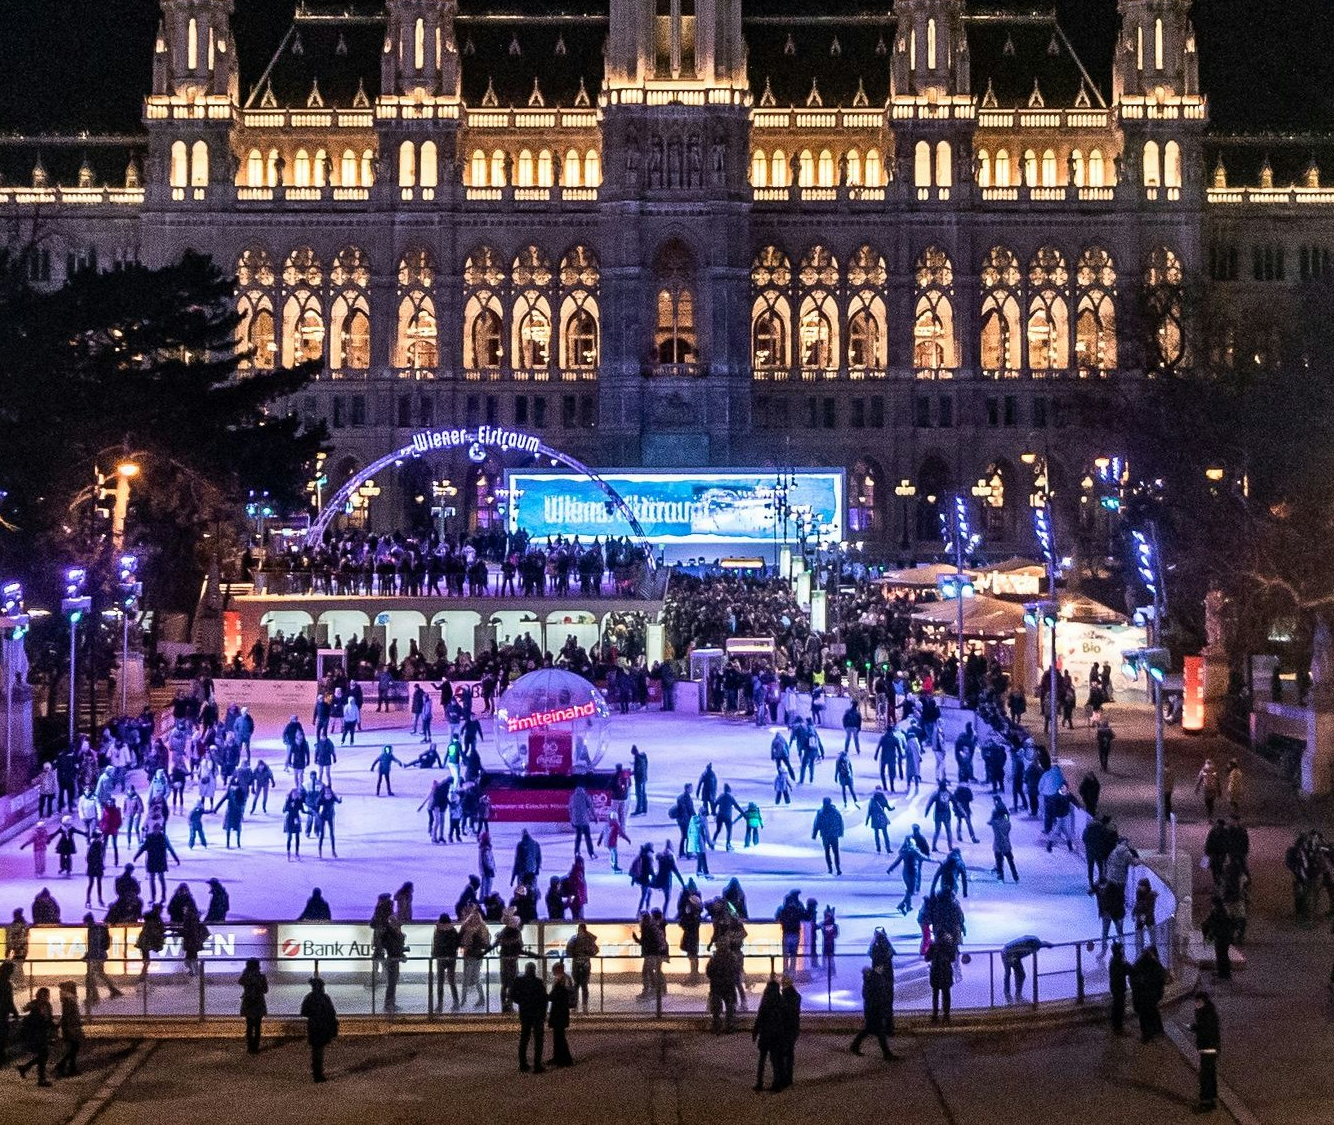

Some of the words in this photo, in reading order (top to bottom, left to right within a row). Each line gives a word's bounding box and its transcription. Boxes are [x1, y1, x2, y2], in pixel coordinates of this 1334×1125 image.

[412, 429, 466, 452] Wiener
[478, 425, 540, 452] Eistraum
[1082, 641, 1101, 654] Bio
[303, 939, 342, 956] Bank
